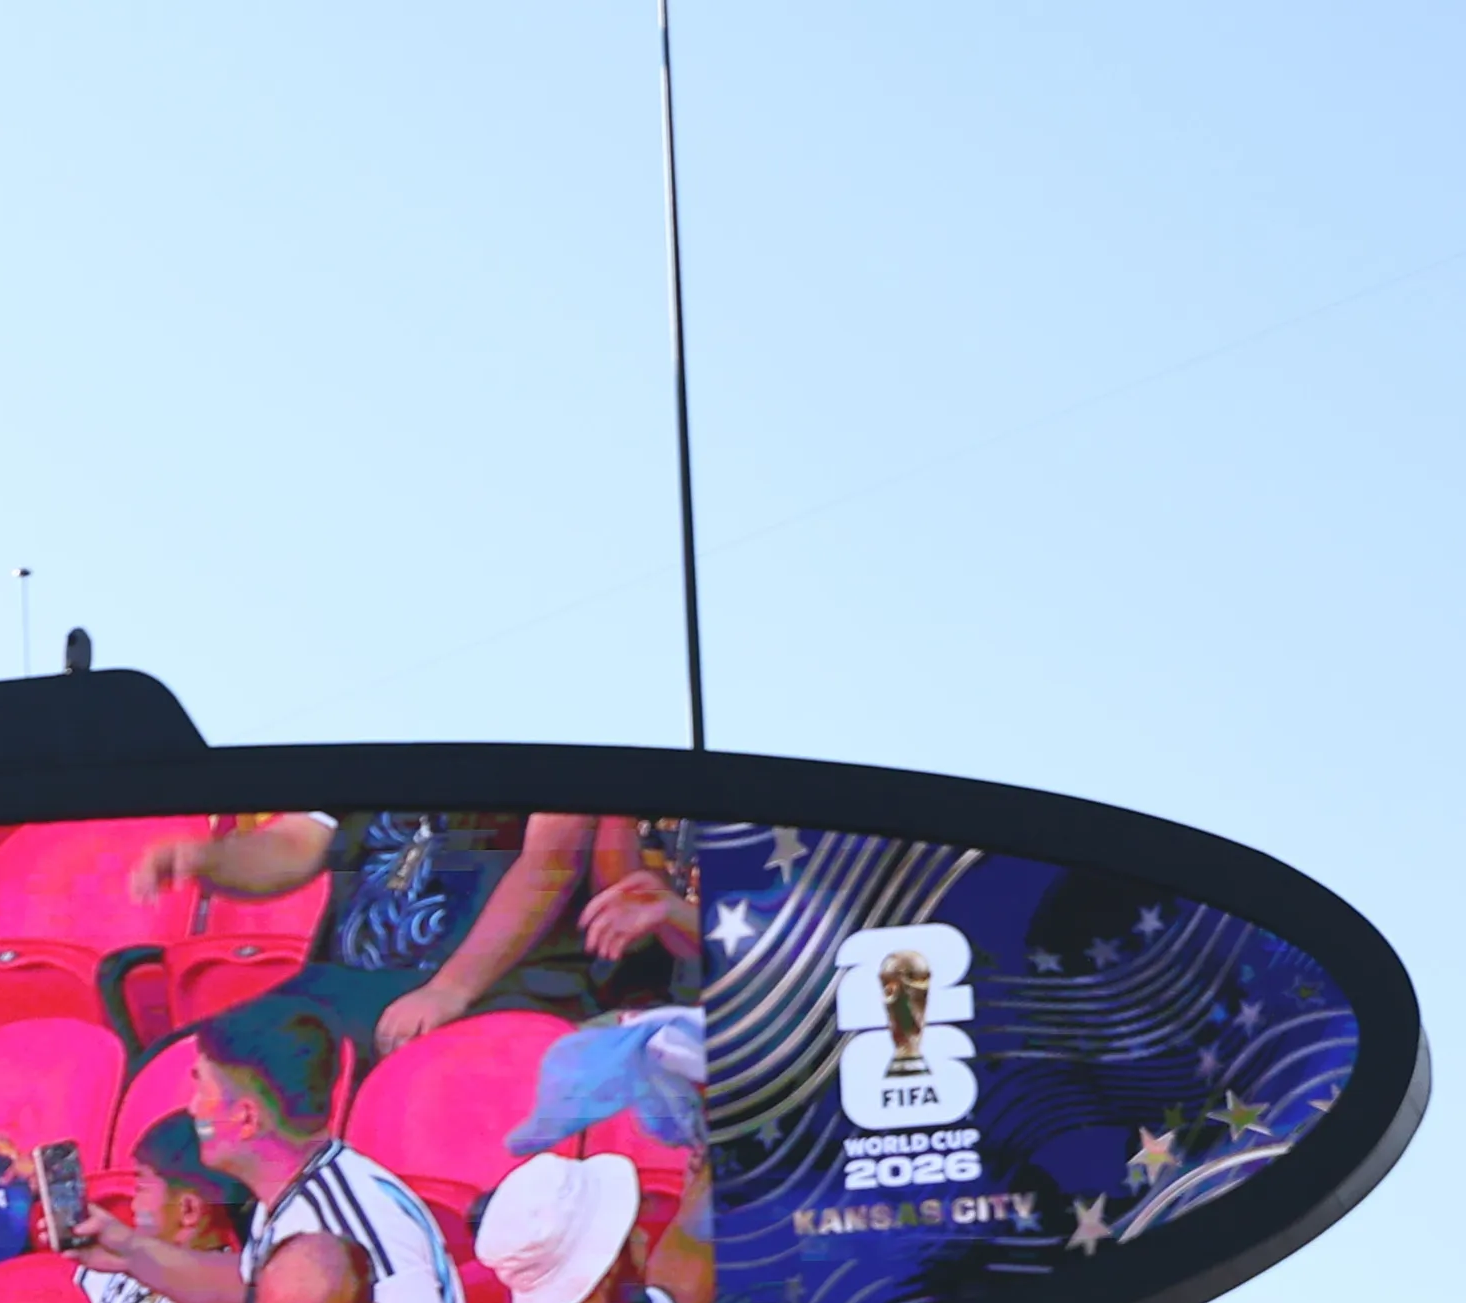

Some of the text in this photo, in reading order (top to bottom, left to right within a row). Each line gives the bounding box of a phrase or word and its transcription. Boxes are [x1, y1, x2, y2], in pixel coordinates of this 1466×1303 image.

[880, 1084, 940, 1109] FIFA
[843, 1128, 980, 1158] WORLD CUP
[844, 1151, 982, 1190] 2026
[793, 1191, 1037, 1237] KANSAS CITY
